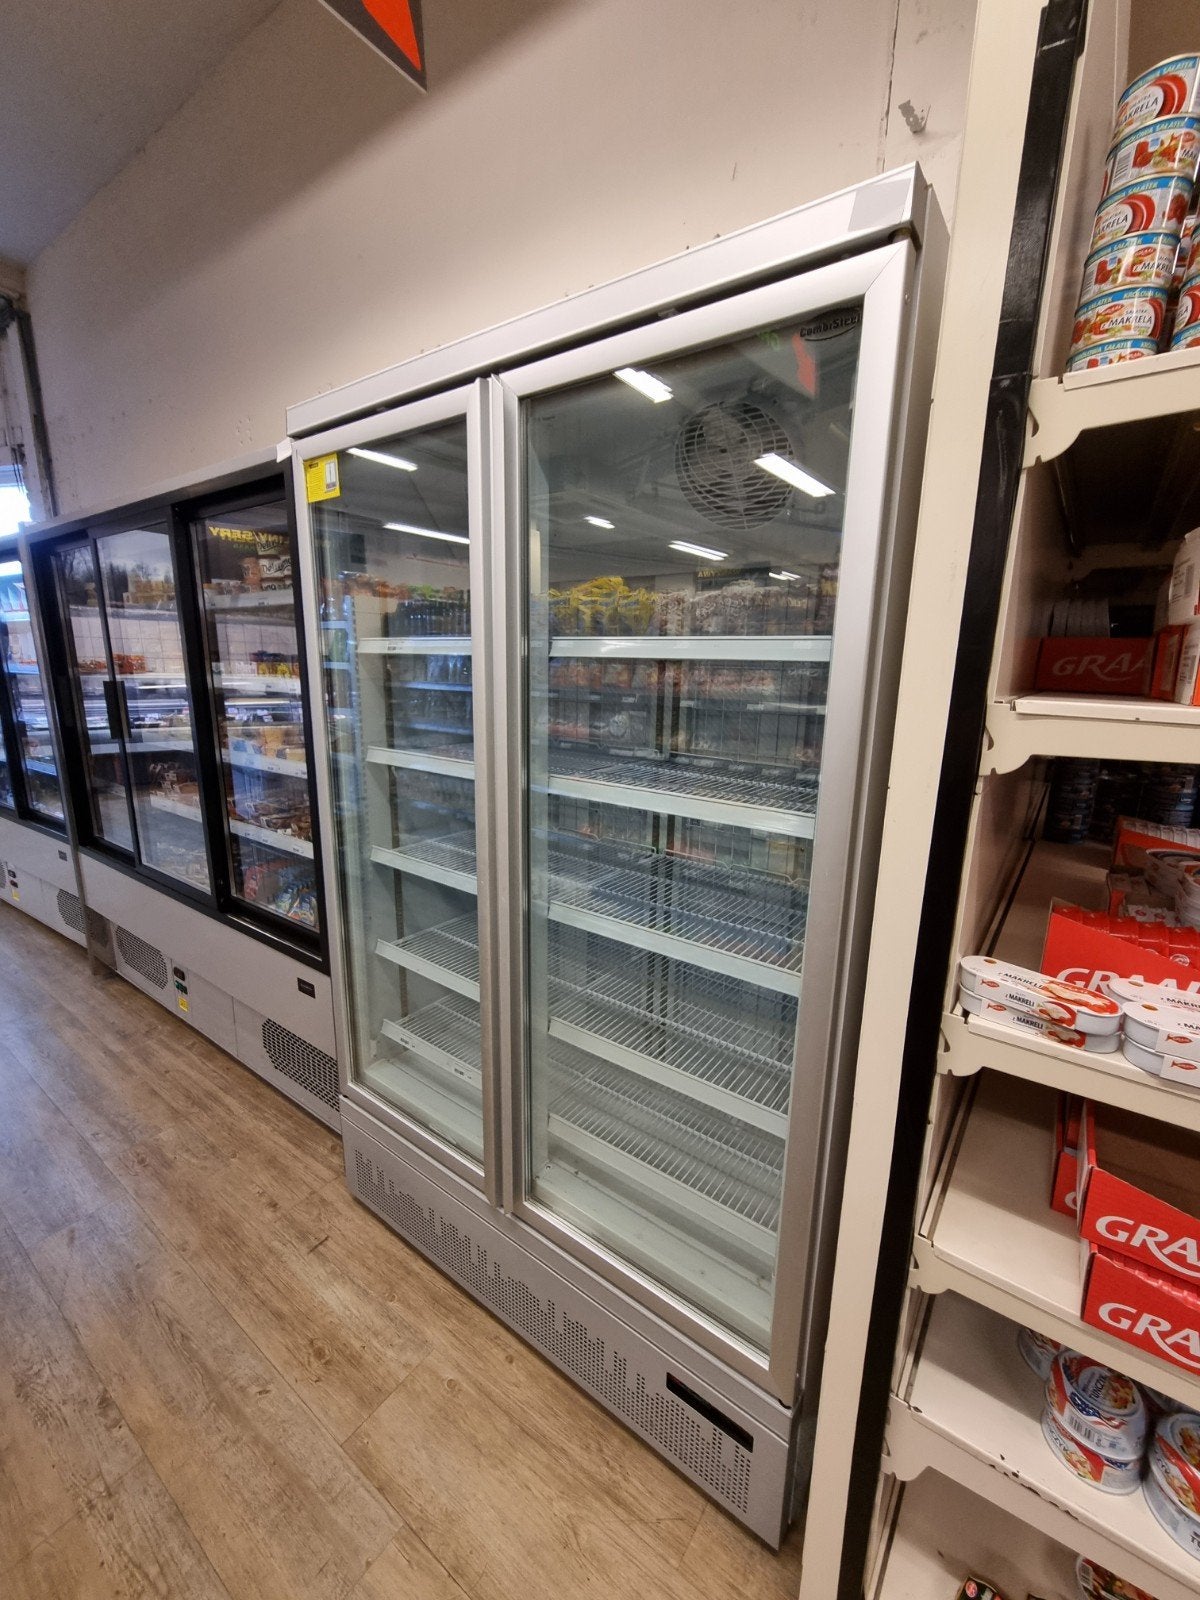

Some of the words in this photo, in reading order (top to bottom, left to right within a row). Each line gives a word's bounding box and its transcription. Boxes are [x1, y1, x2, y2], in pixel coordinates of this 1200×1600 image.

[1009, 993, 1035, 1007] MAKRELI
[1016, 1016, 1044, 1030] MAKRELI
[1095, 1215, 1200, 1278] GRA
